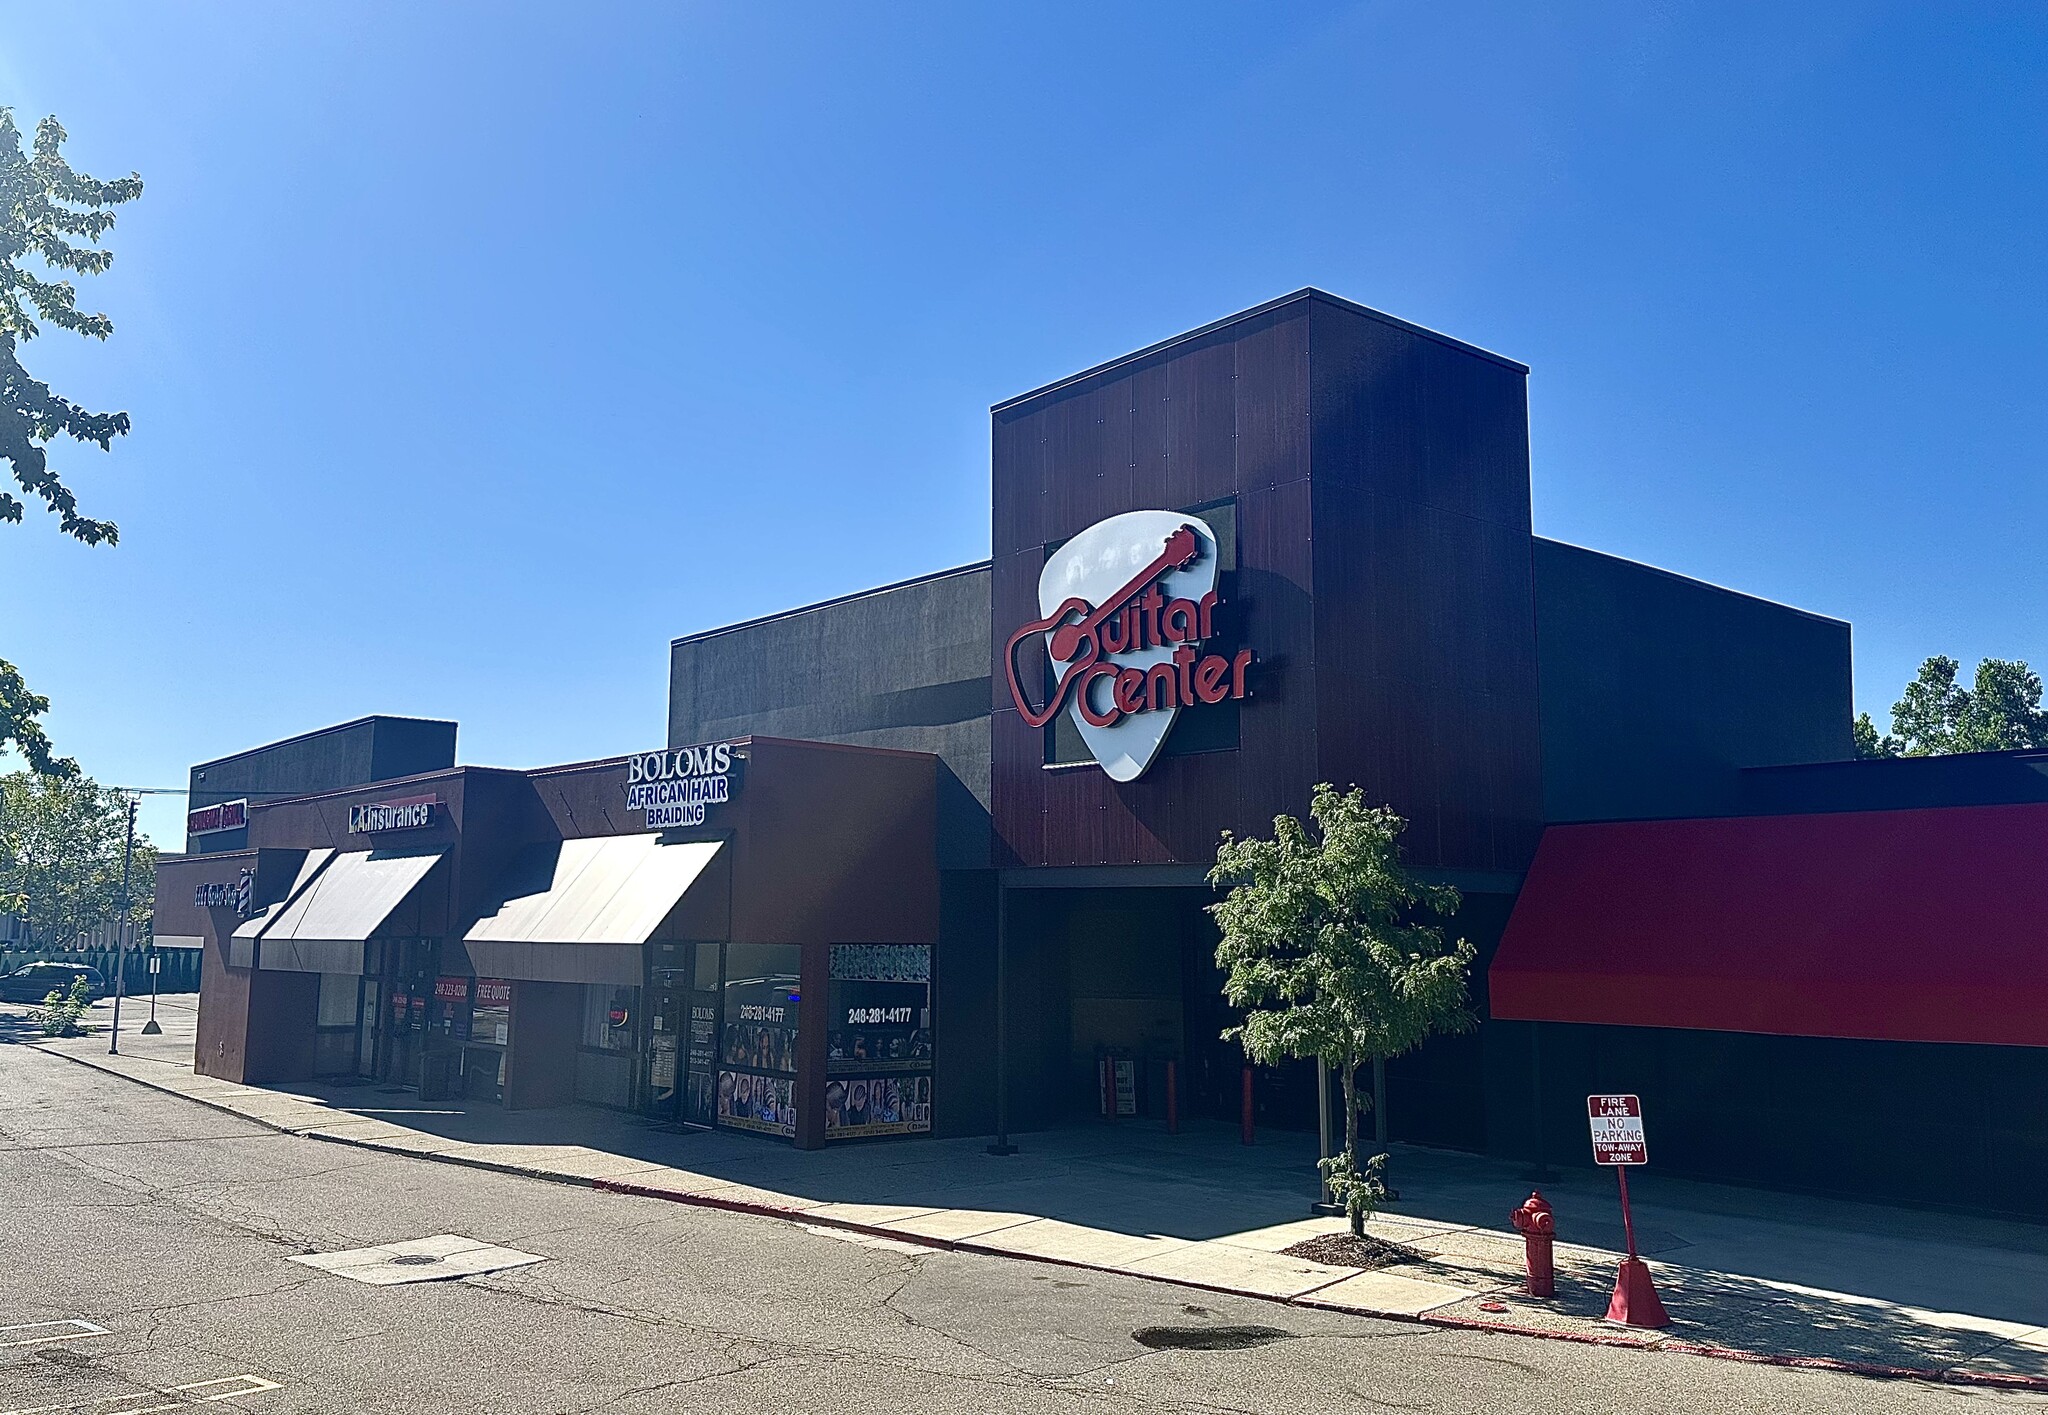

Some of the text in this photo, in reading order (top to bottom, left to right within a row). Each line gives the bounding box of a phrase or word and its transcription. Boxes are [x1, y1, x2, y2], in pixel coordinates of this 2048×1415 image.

[1077, 645, 1252, 728] Center
[627, 743, 731, 783] BOLOMS
[628, 777, 727, 808] AFRICAN HAIR
[367, 803, 428, 831] Insurance
[647, 804, 703, 826] BRAIDING
[477, 984, 511, 1000] FREE QUOTE
[692, 1006, 715, 1020] BOLOMS
[740, 1004, 785, 1022] 248-281-4177
[848, 1007, 912, 1024] 248-281-4177
[1600, 1097, 1627, 1107] FIRE
[1600, 1107, 1630, 1116] LANE
[1607, 1117, 1625, 1129] NO
[1594, 1130, 1642, 1142] PARKING
[1596, 1143, 1642, 1152] TOW-AWAY
[1609, 1153, 1633, 1162] ZONE
